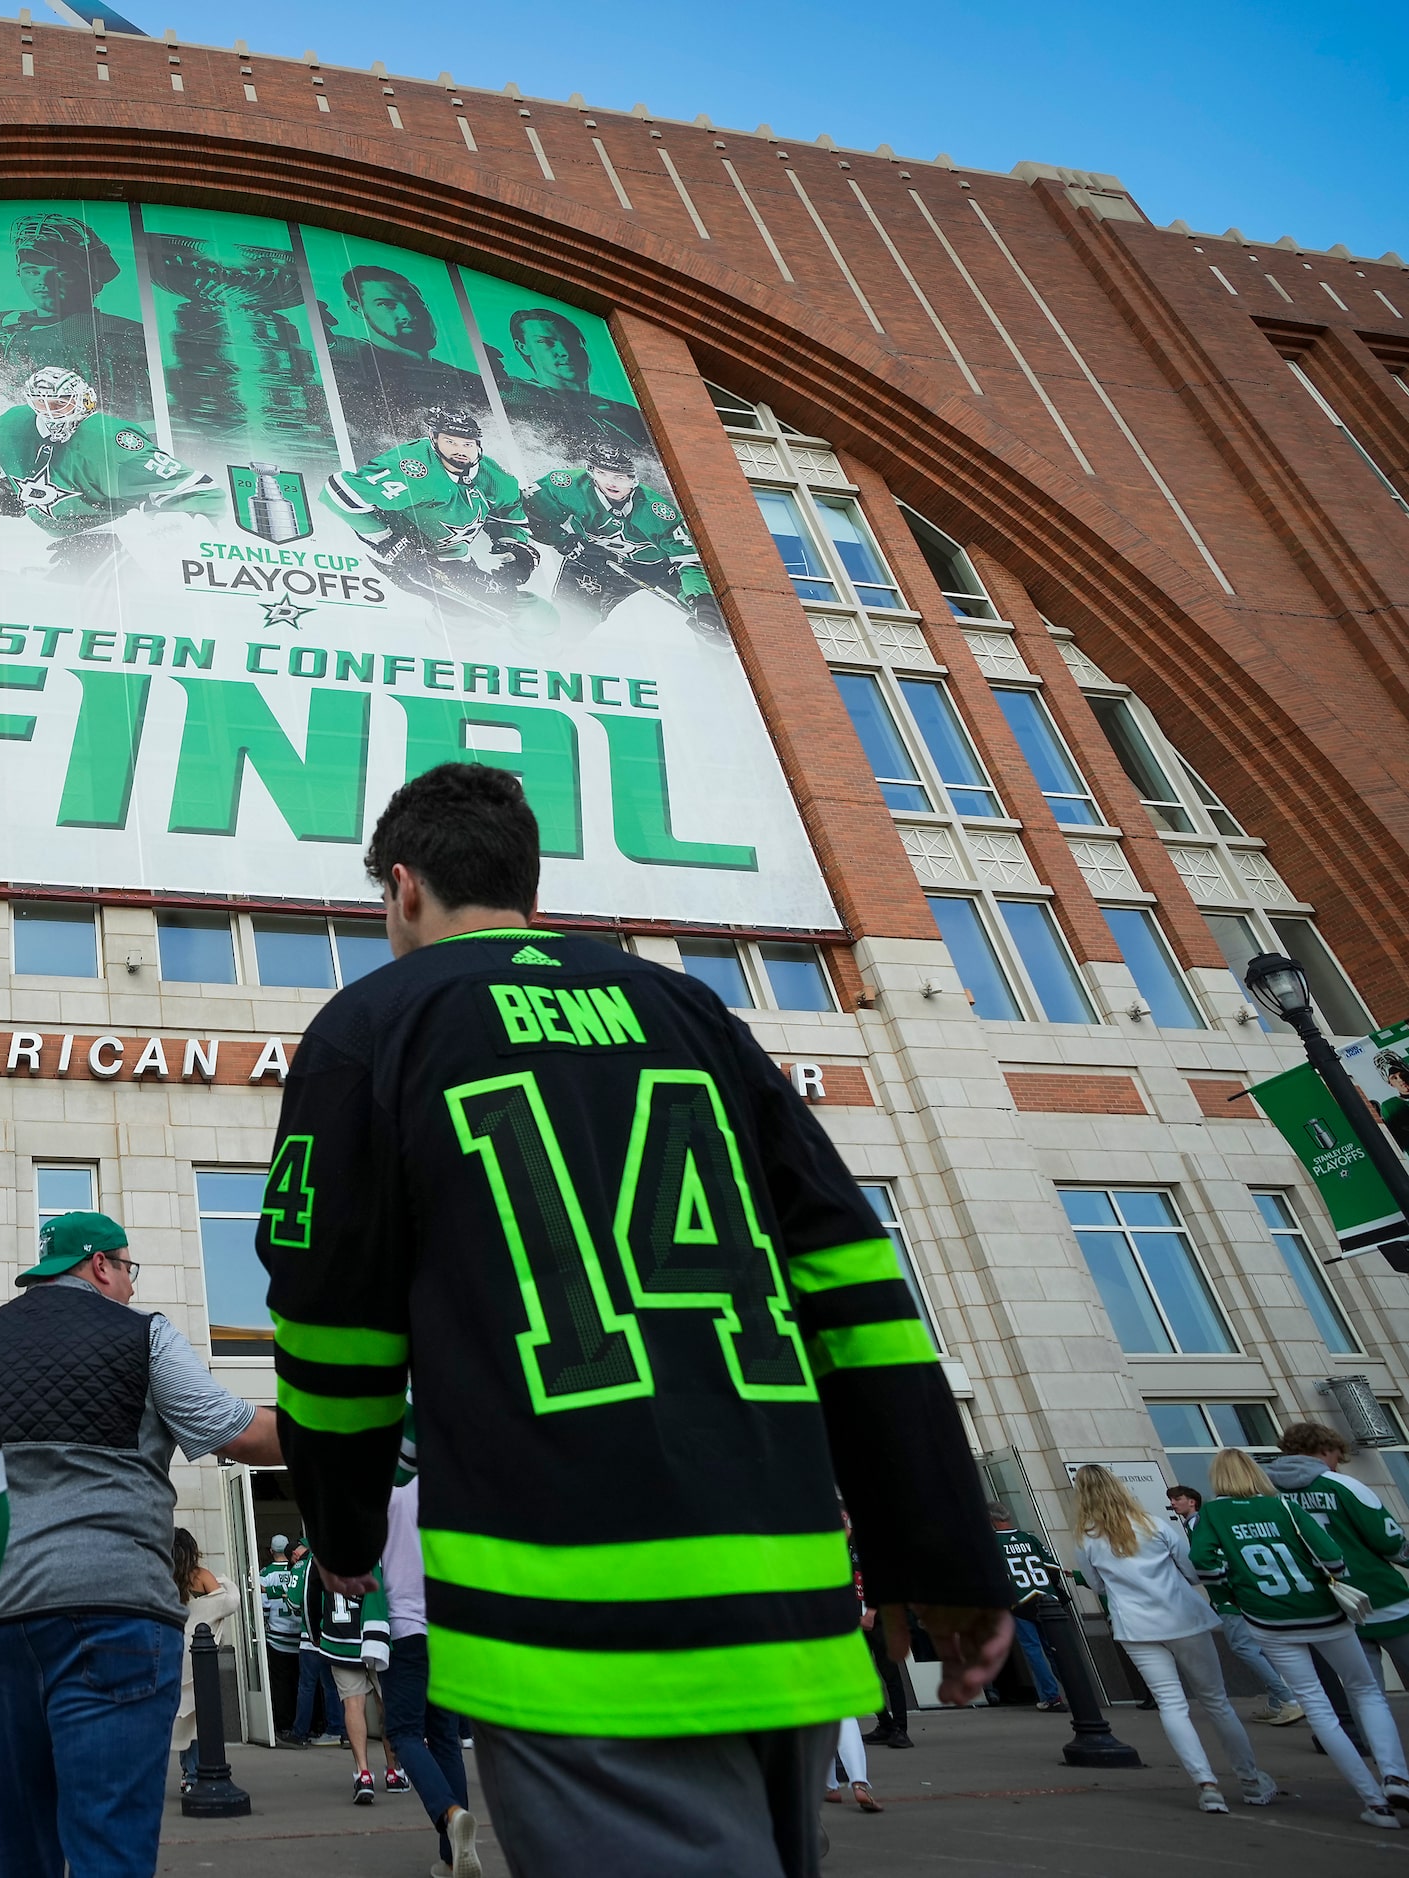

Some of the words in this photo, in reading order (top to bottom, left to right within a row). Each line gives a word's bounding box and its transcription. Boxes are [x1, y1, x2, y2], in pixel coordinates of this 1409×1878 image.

[144, 451, 182, 480] 29
[237, 479, 252, 488] 20
[283, 484, 298, 493] 23
[365, 468, 409, 500] 14
[199, 542, 306, 567] STANLEY
[313, 553, 360, 572] CUP
[384, 537, 411, 562] AUER
[181, 559, 386, 603] PLAYOFFS
[245, 641, 659, 710] CONFERENCE
[489, 983, 647, 1046] BENN
[1312, 1147, 1365, 1177] PLAYOFFS
[1313, 1147, 1342, 1165] STANLEY
[1340, 1143, 1354, 1155] CUP
[443, 1067, 821, 1416] 14
[1232, 1522, 1281, 1540] SEGUIN
[1003, 1543, 1032, 1555] ZUBOV
[1007, 1555, 1050, 1588] 56
[1241, 1543, 1315, 1597] 91
